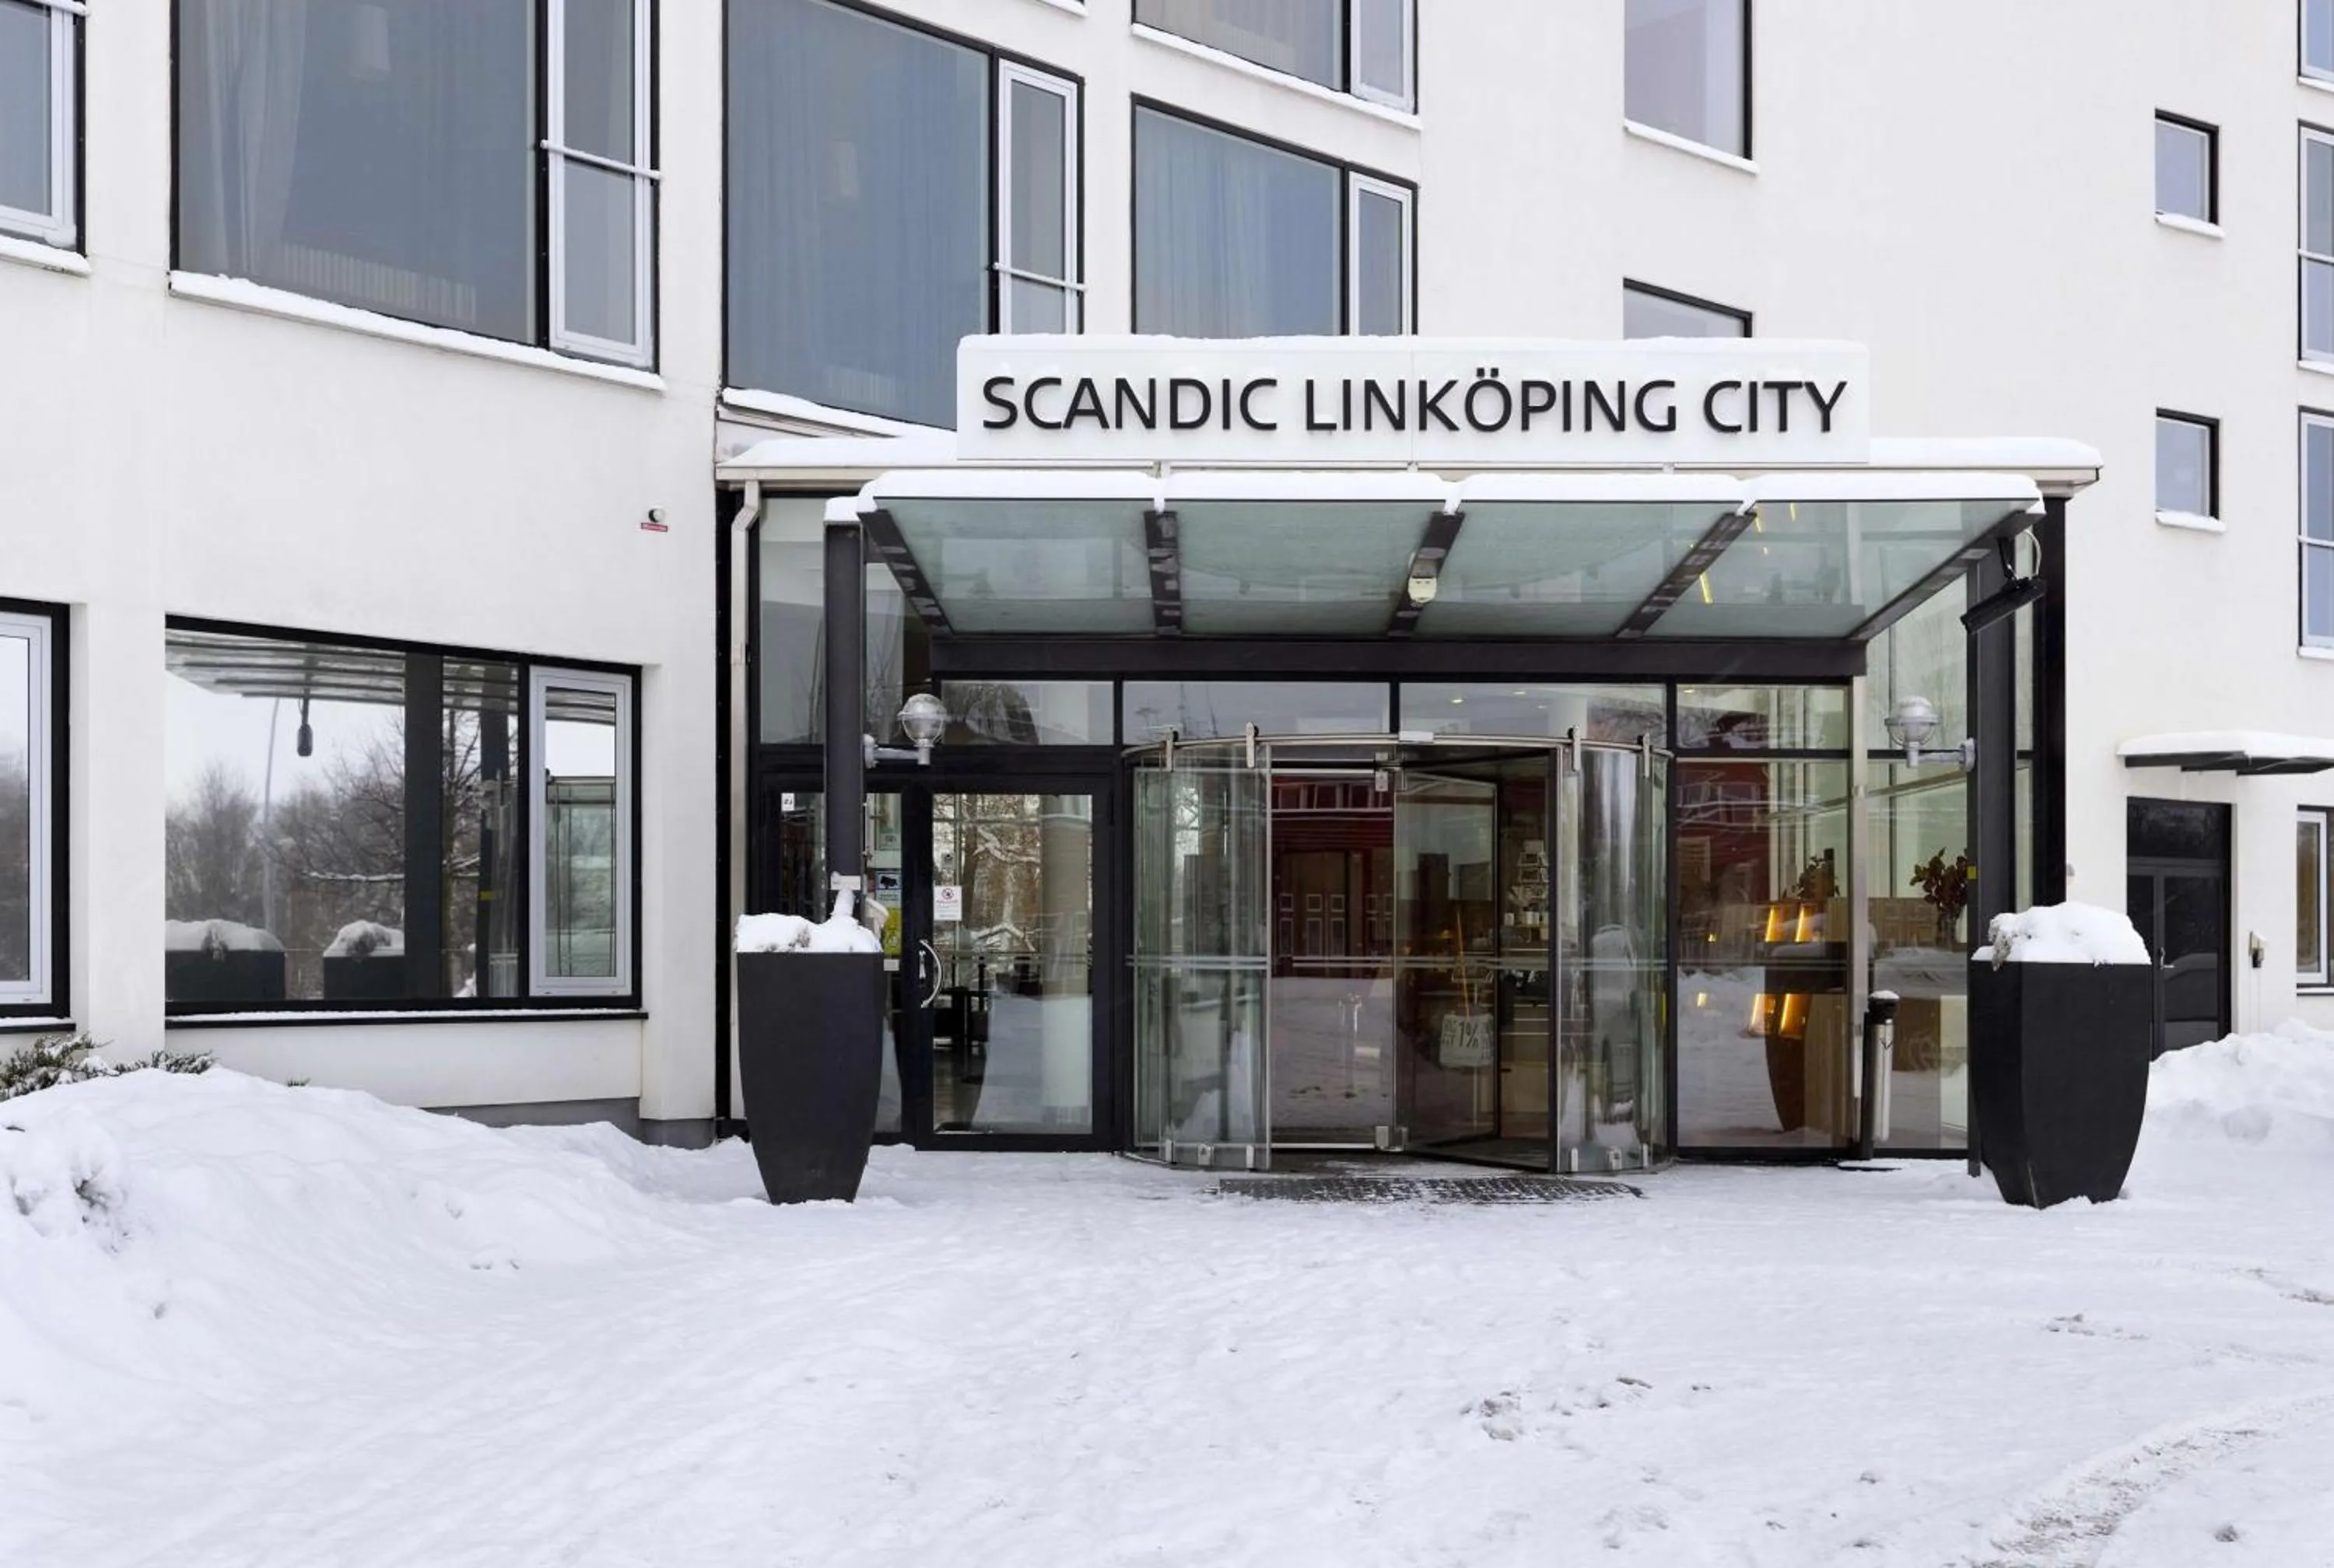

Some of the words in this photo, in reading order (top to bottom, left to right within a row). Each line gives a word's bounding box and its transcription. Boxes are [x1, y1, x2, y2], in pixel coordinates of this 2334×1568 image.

[982, 376, 1277, 432] SCANDIC
[1305, 367, 1677, 433] LINKÖPING
[1702, 380, 1849, 434] CITY
